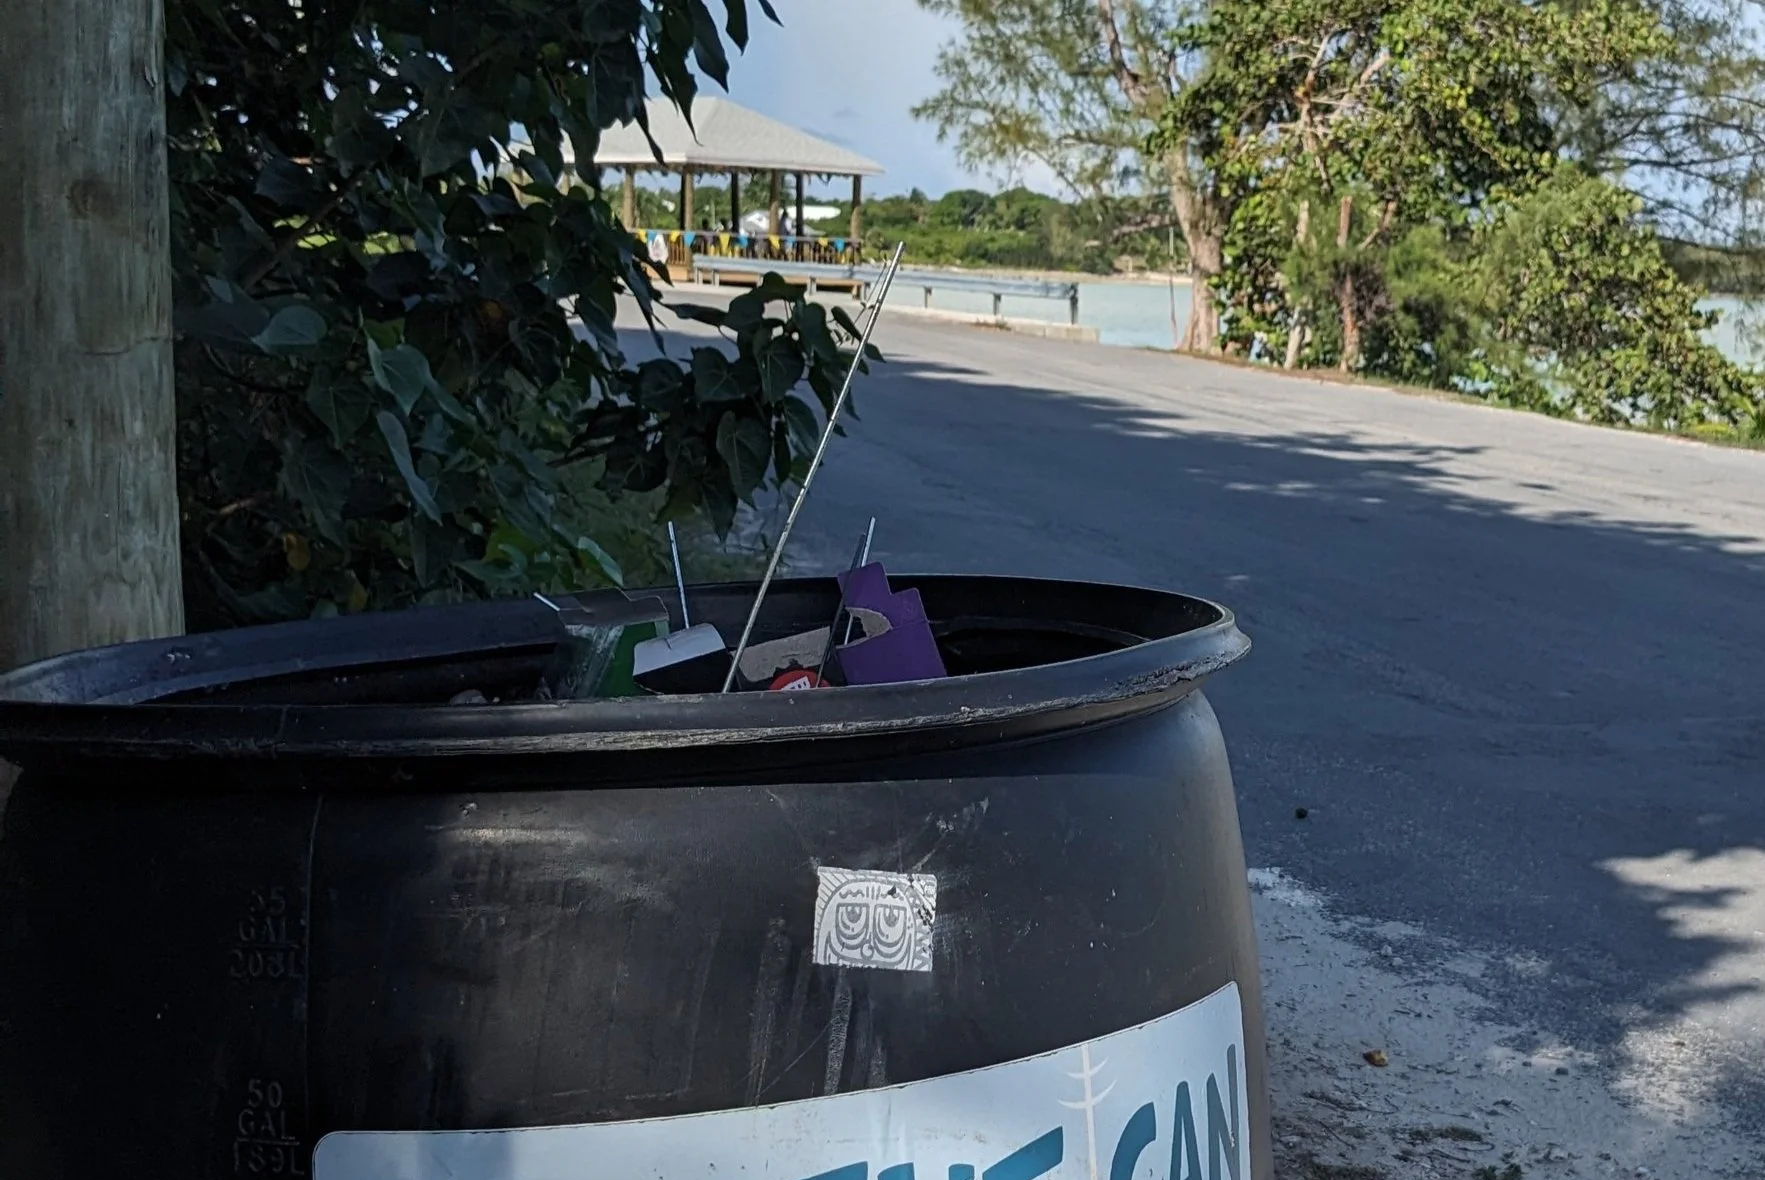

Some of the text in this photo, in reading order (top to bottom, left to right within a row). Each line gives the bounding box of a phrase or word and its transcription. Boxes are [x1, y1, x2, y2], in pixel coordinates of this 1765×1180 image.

[247, 1078, 283, 1109] 50
[237, 1108, 296, 1140] GAL
[233, 1141, 305, 1176] 189L
